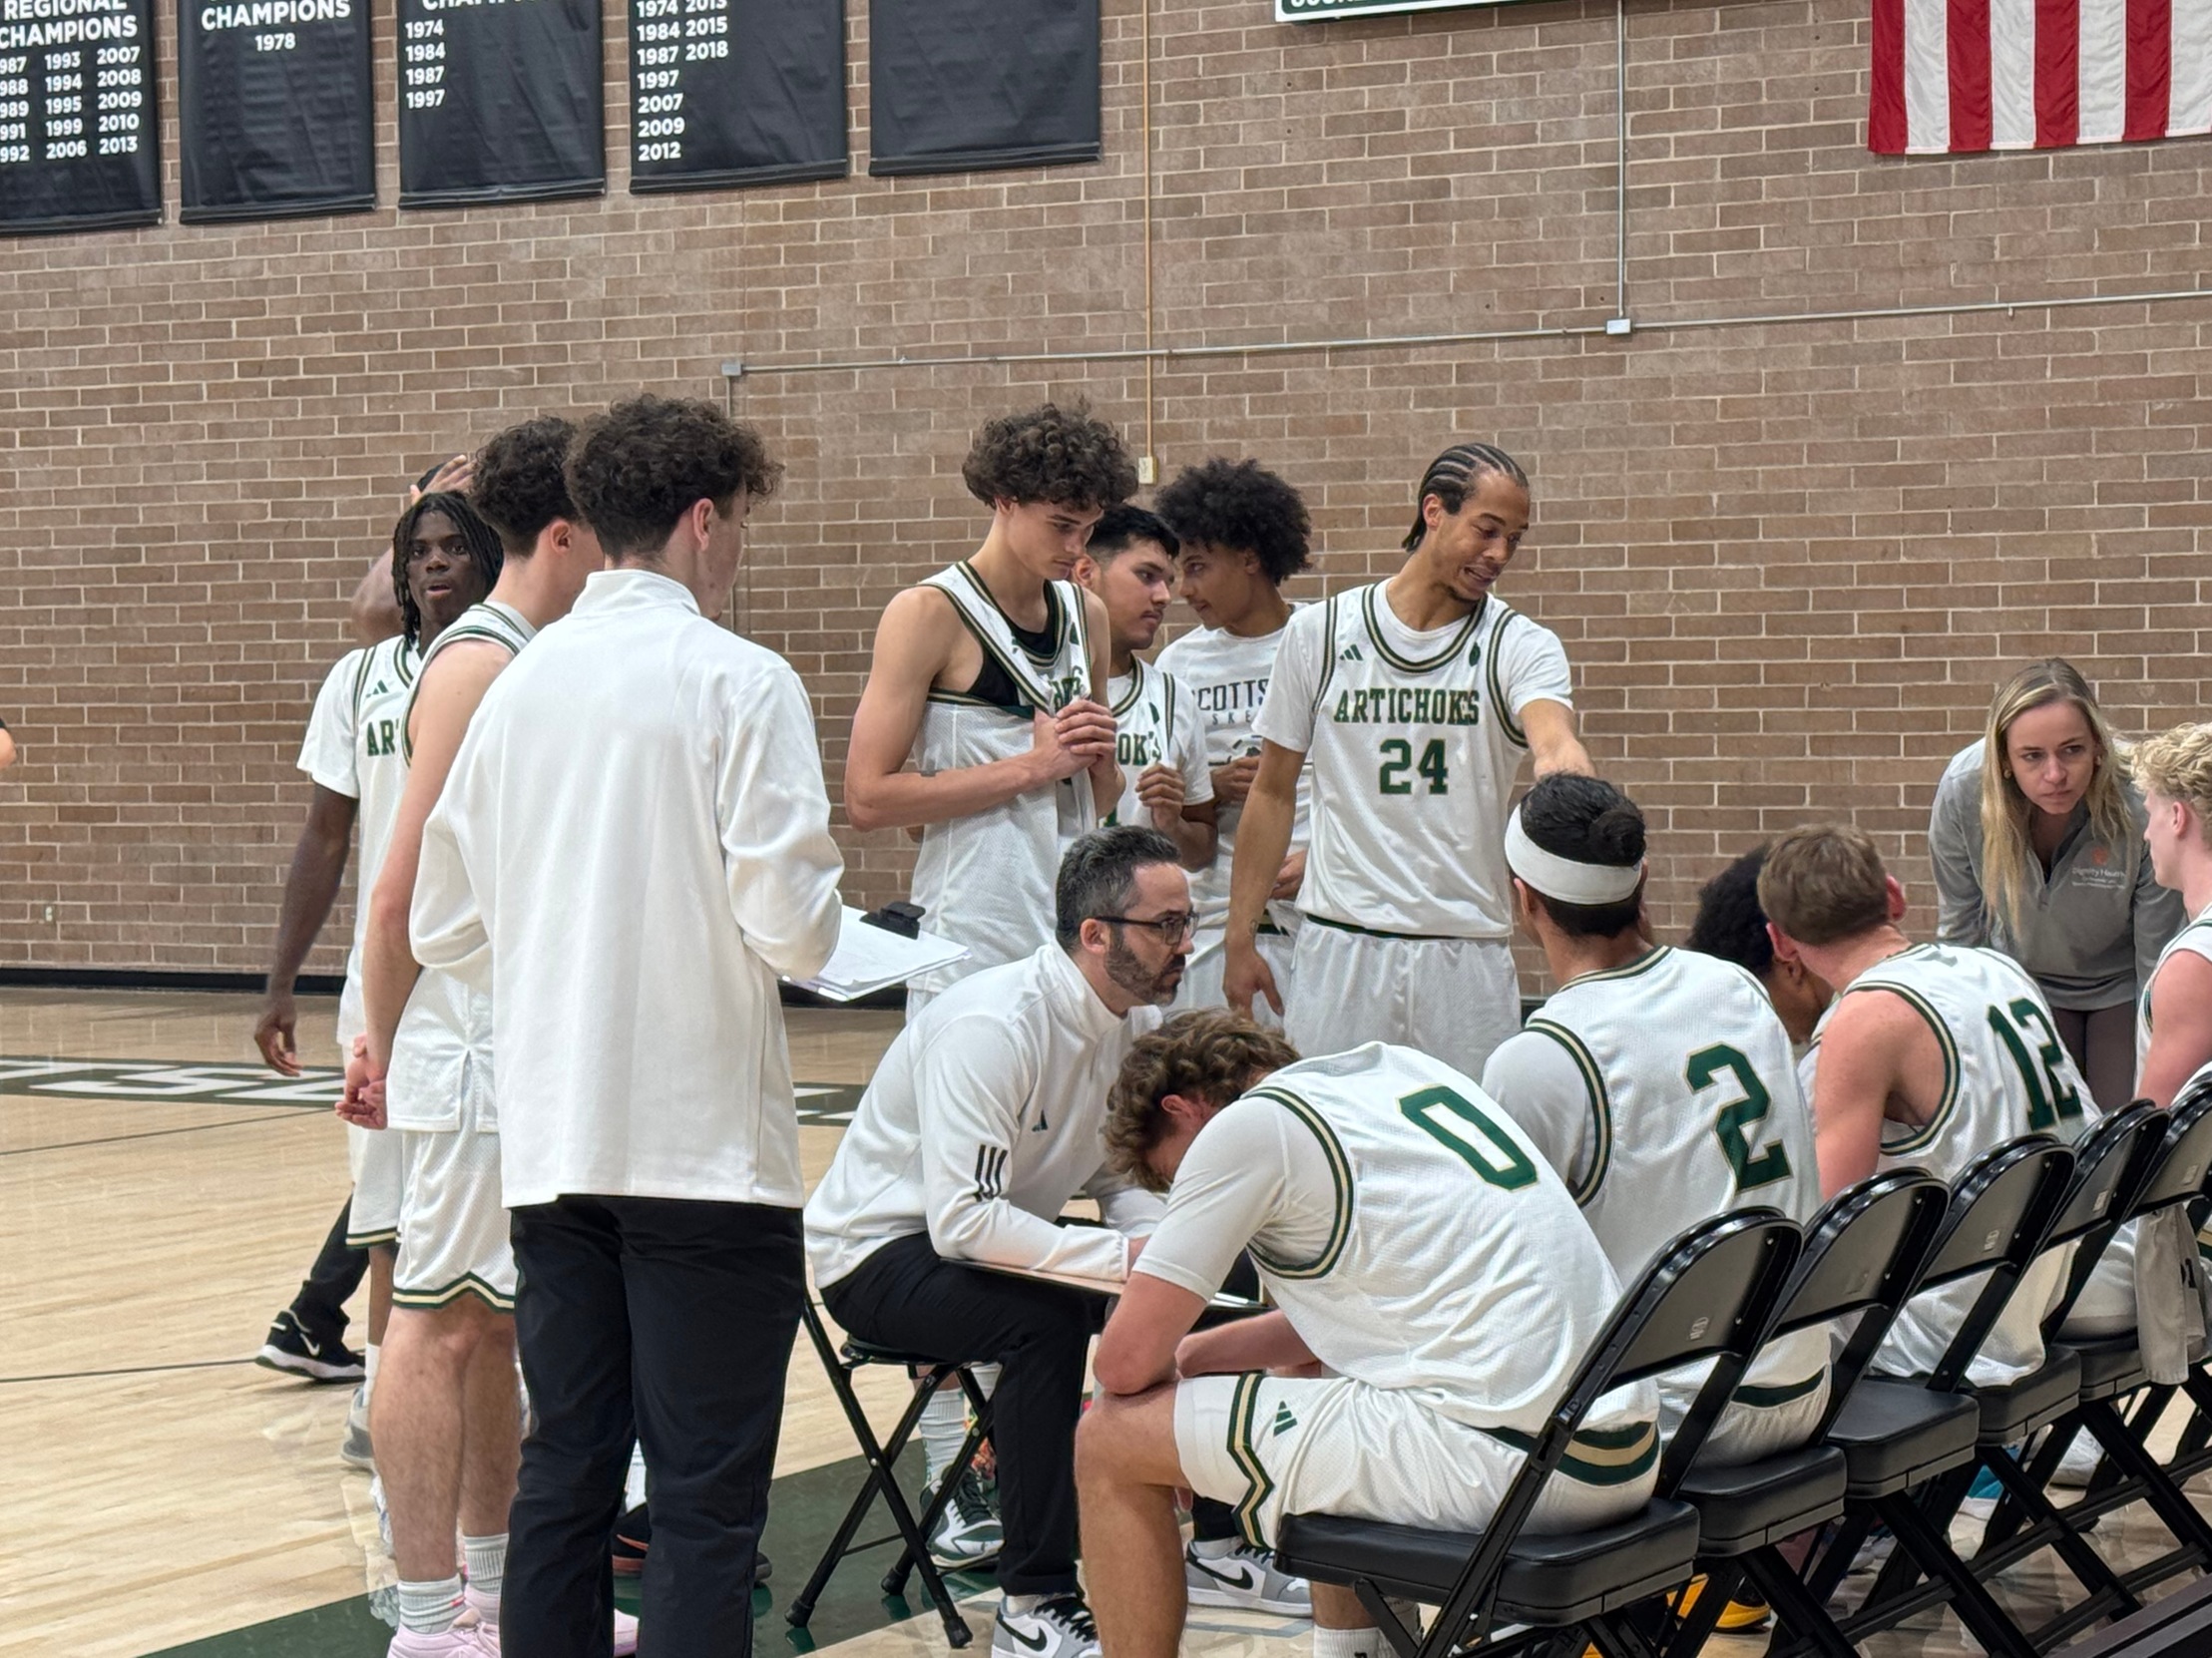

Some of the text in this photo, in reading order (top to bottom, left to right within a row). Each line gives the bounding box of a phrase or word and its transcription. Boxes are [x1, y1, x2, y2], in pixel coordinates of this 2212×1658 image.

[202, 0, 350, 30] CHAMPIONS
[637, 0, 678, 17] 1974
[0, 15, 138, 50] CHAMPIONS
[255, 33, 295, 51] 1978
[405, 19, 444, 39] 1974
[637, 16, 727, 41] 1984 2015
[0, 46, 140, 74] 987 1993 2007
[406, 42, 445, 62] 1984
[638, 41, 728, 65] 1987 2018
[0, 69, 142, 96] 988 1994 2008
[406, 66, 444, 85] 1987
[638, 70, 678, 90] 1997
[0, 91, 142, 118] 989 1995 2009
[406, 89, 445, 109] 1997
[639, 93, 683, 113] 2007
[0, 114, 139, 141] 991 1999 2010
[639, 117, 684, 137] 2009
[0, 136, 138, 163] 992 2006 2013
[639, 142, 680, 161] 2012
[1192, 678, 1269, 711] COTTS
[367, 719, 398, 756] AR
[1379, 738, 1449, 795] 24
[1987, 997, 2083, 1131] 12
[1683, 1040, 1793, 1193] 2
[1396, 1083, 1541, 1192] 0
